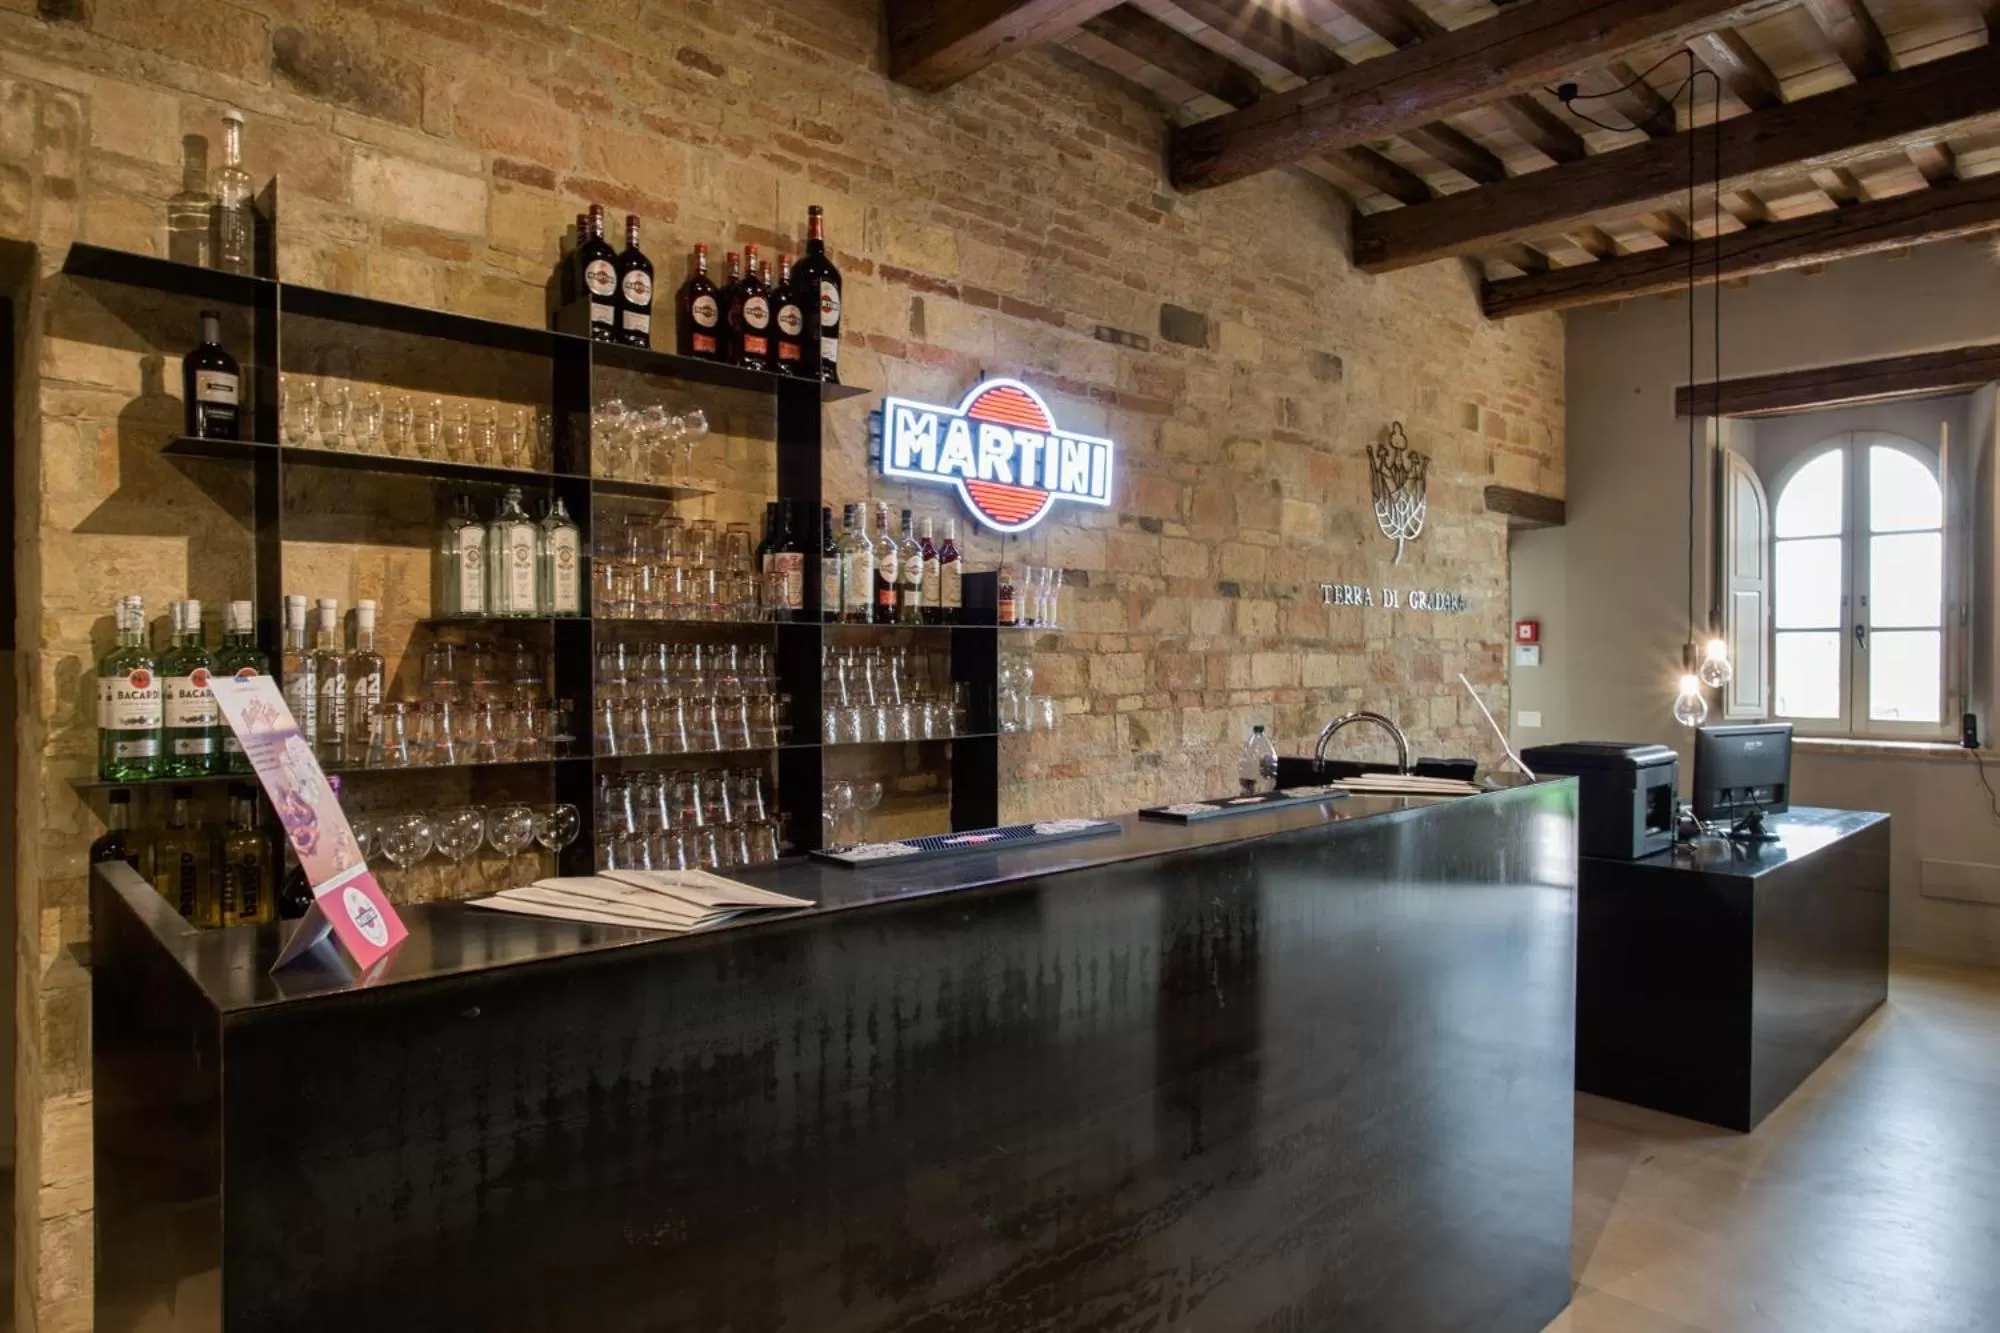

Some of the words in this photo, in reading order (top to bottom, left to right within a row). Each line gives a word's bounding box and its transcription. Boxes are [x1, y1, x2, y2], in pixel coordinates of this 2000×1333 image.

[894, 407, 1105, 497] MARTINI
[1320, 583, 1374, 607] TERRA
[1382, 588, 1400, 609] DI
[179, 689, 215, 699] BACAR
[321, 673, 346, 697] 42
[353, 673, 381, 697] 42
